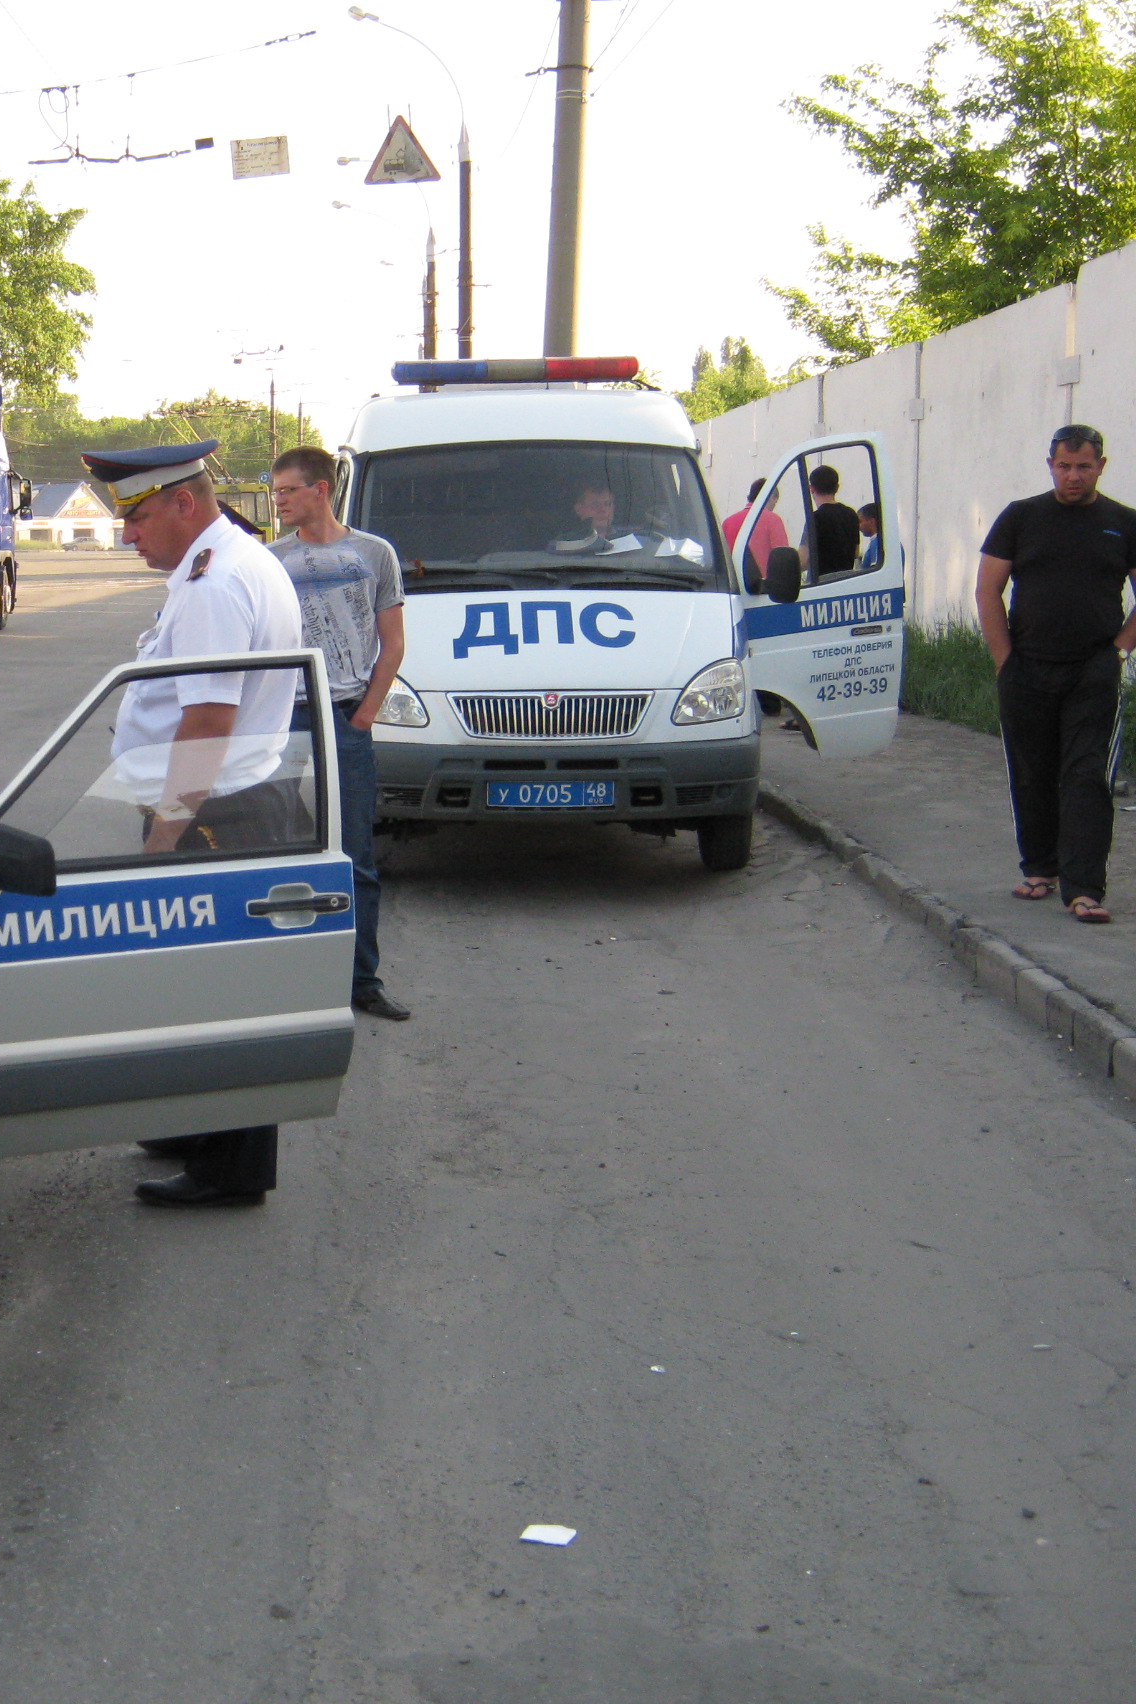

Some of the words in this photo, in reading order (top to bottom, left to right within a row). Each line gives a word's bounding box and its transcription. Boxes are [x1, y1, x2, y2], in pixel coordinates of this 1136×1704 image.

[800, 593, 892, 628] МИЛИЦИЯ
[452, 600, 637, 659] ДПС
[812, 646, 853, 659] ТЕЛЕФОН
[854, 640, 893, 655] ДОВЕРИЯ
[844, 656, 862, 668] ДПС
[810, 668, 856, 684] ЛИПЕЦКОЙ
[858, 663, 895, 677] ОБЛАСТИ
[816, 677, 888, 702] 42-39-39
[519, 784, 572, 803] 0705
[586, 782, 606, 798] 48
